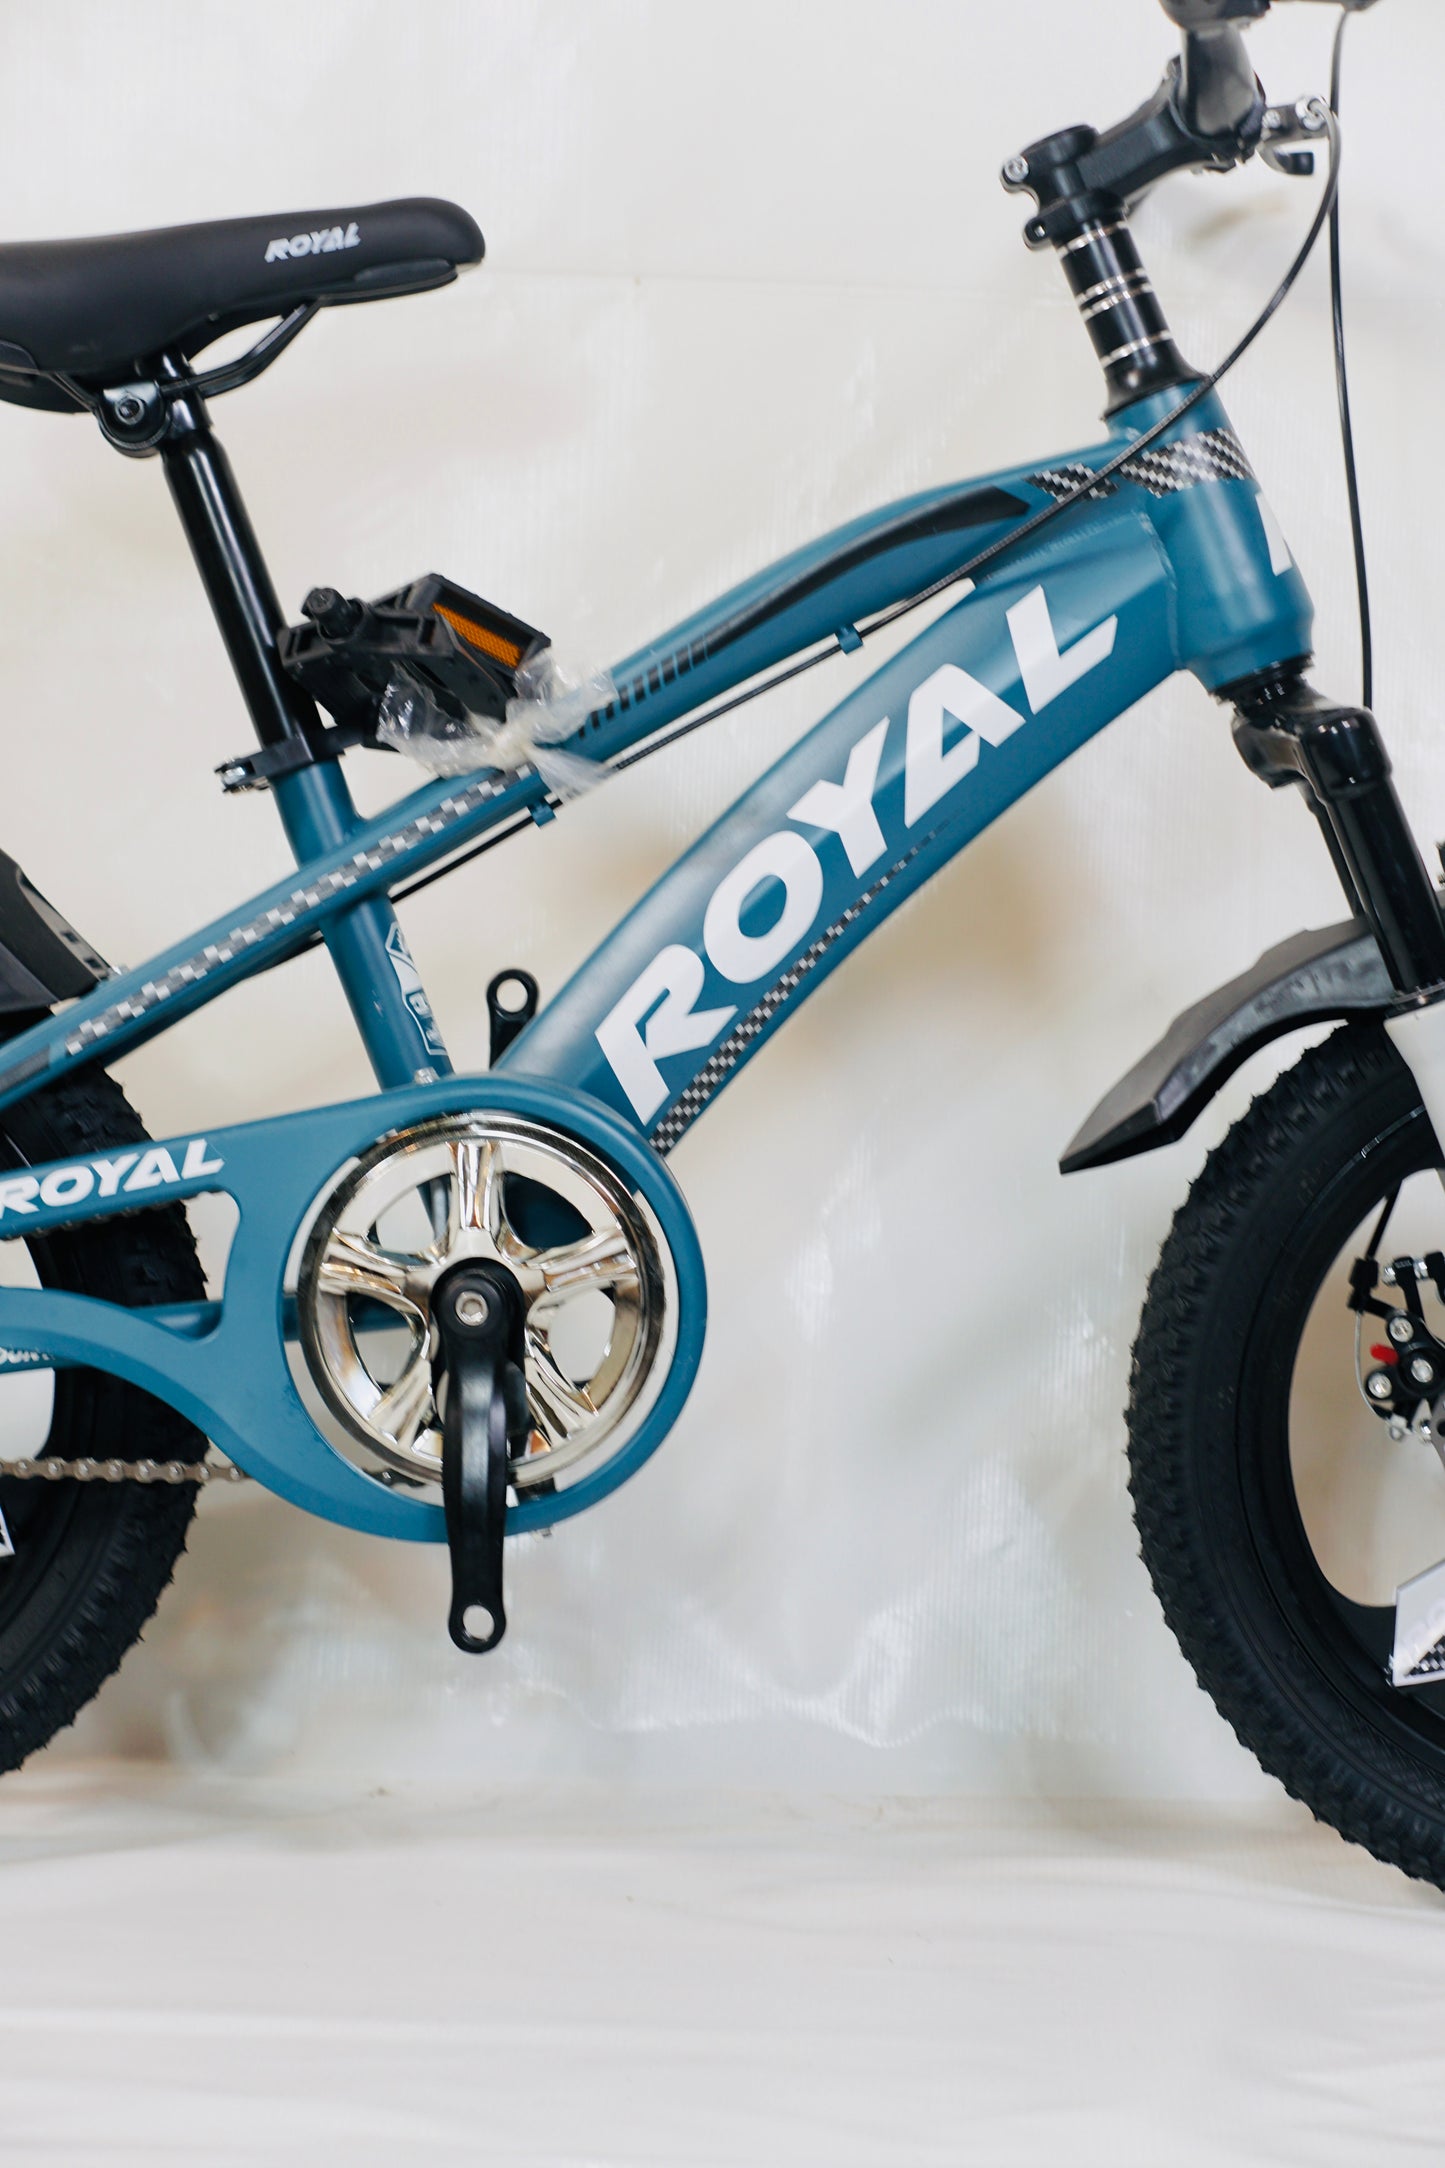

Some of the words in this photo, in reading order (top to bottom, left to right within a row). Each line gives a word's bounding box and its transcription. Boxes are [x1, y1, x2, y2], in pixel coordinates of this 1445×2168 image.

[264, 222, 361, 263] ROYAL
[594, 584, 1119, 1126] ROYAL
[0, 1138, 225, 1219] ROYAL
